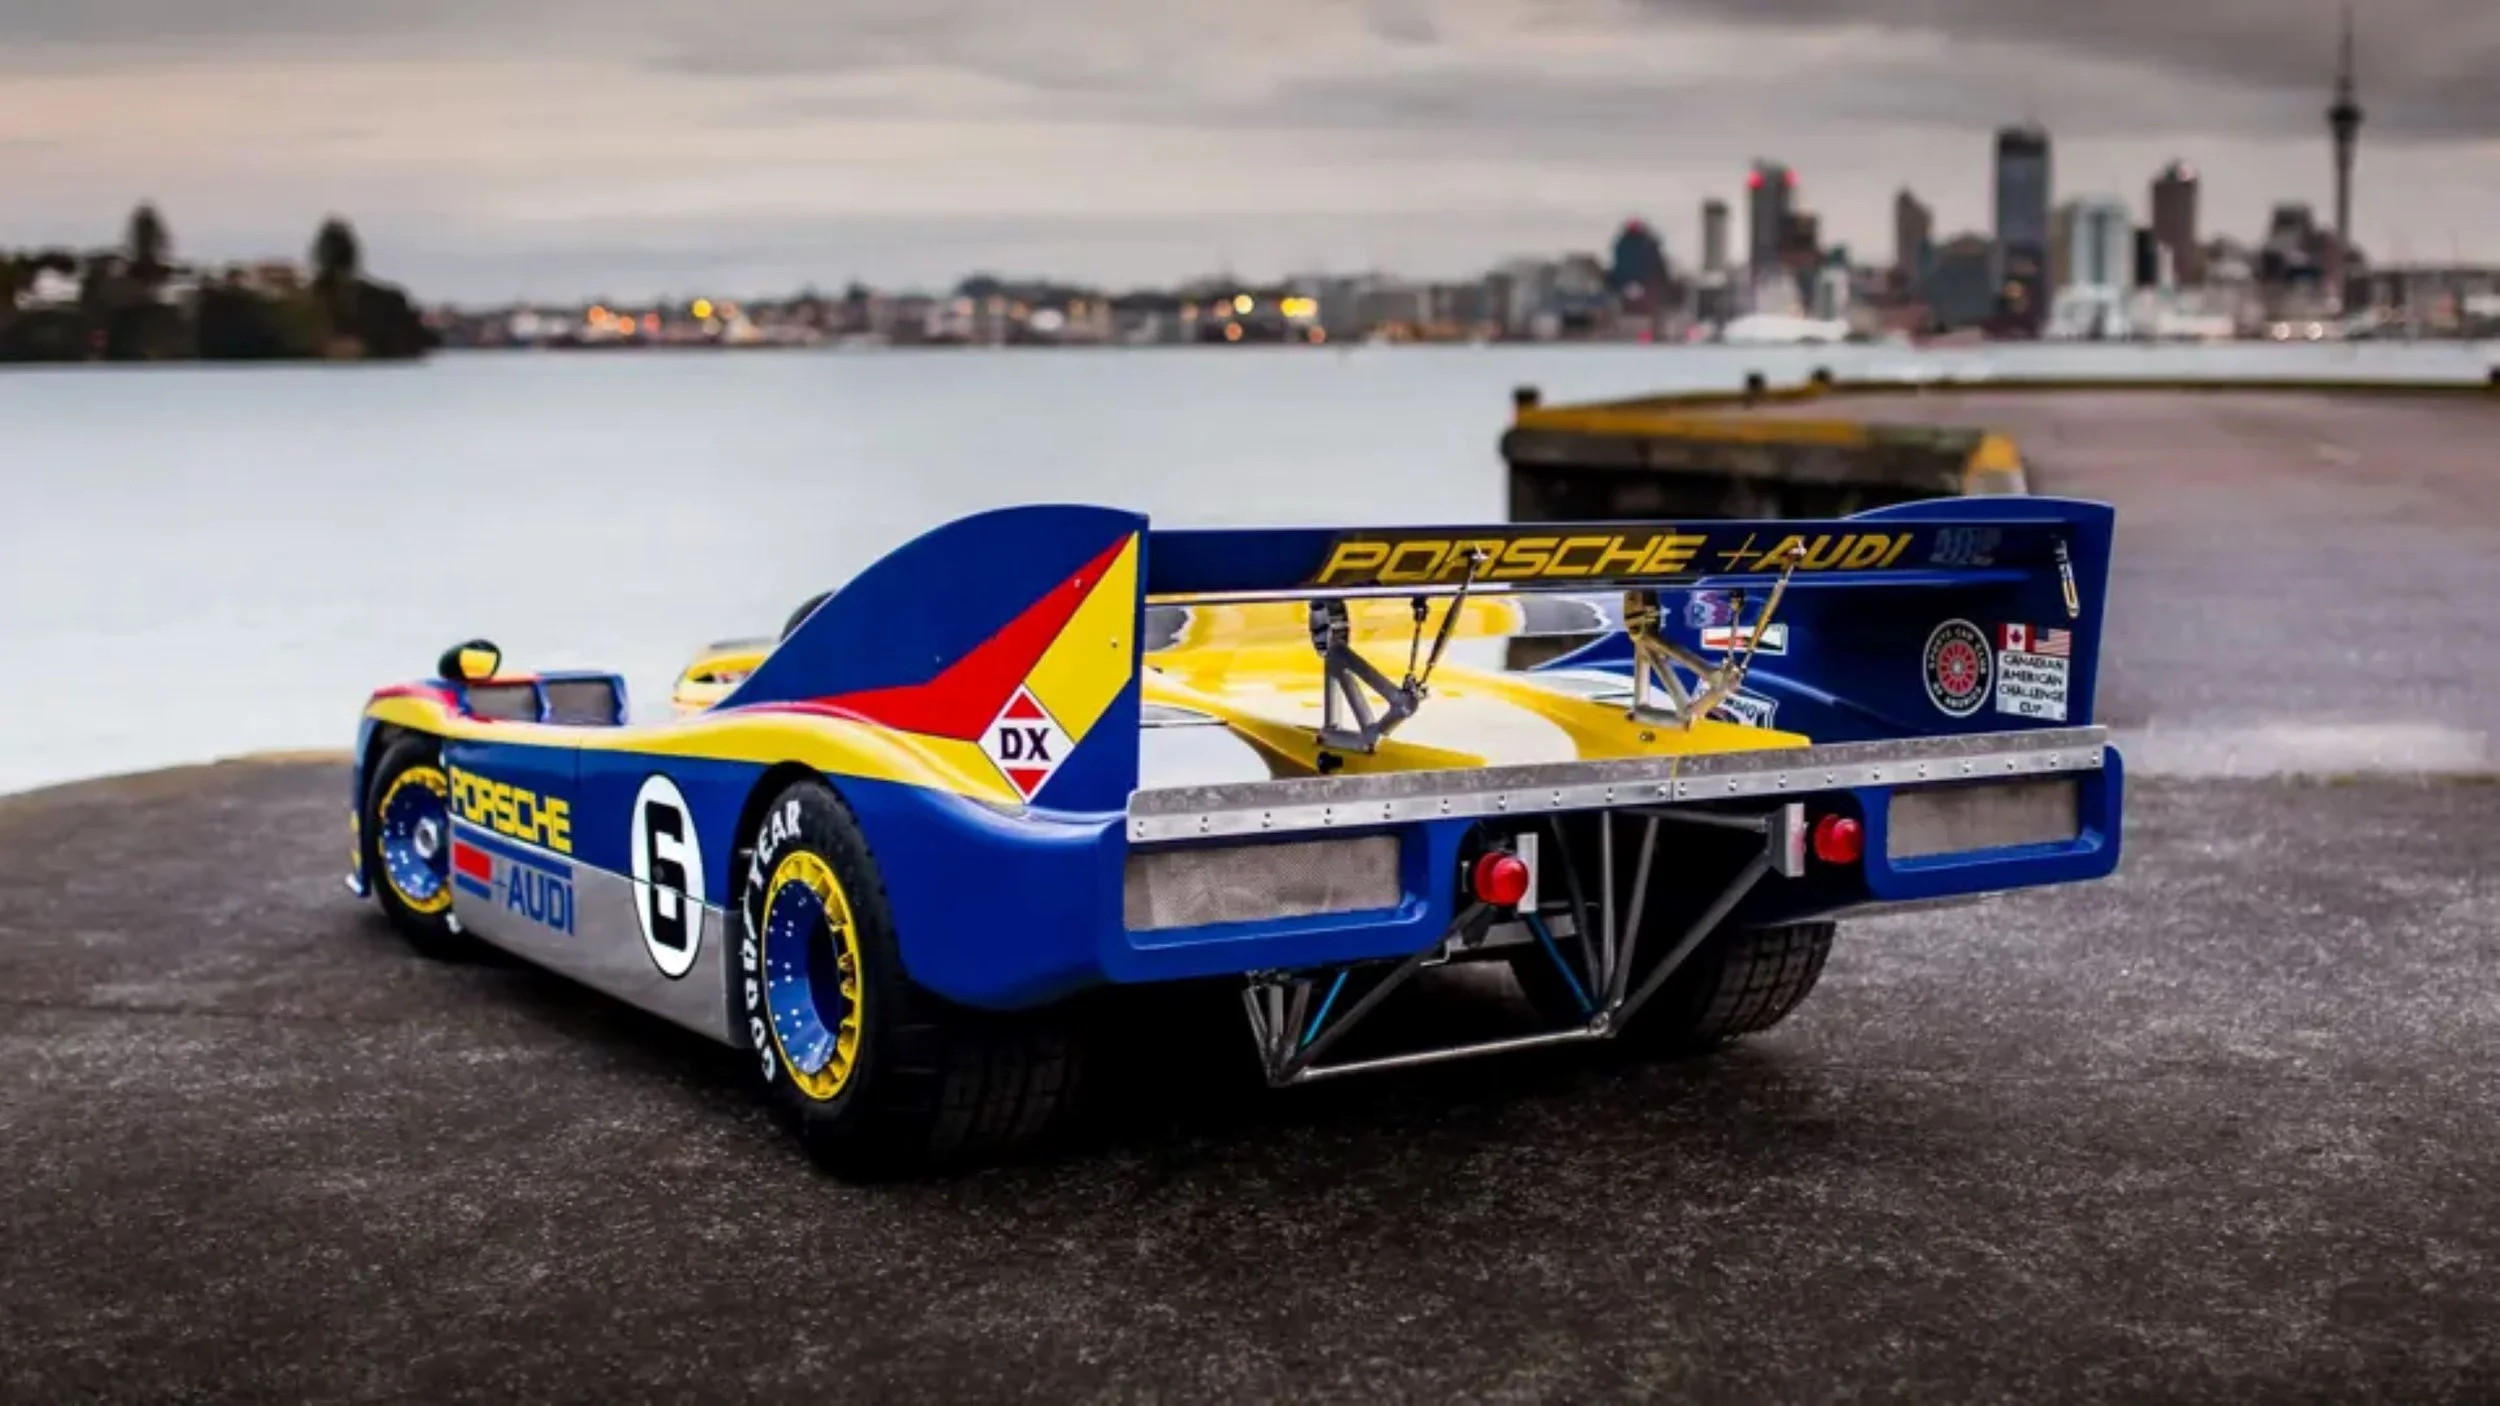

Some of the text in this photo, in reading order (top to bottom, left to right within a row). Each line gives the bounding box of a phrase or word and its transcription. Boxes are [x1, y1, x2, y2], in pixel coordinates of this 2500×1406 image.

[1316, 535, 1707, 583] PORSCHE
[1999, 684, 2065, 702] CHALLENGE
[2002, 669, 2063, 686] AMERICAN
[1000, 727, 1051, 761] DX
[450, 766, 573, 853] PORSCHE
[646, 800, 687, 952] 6
